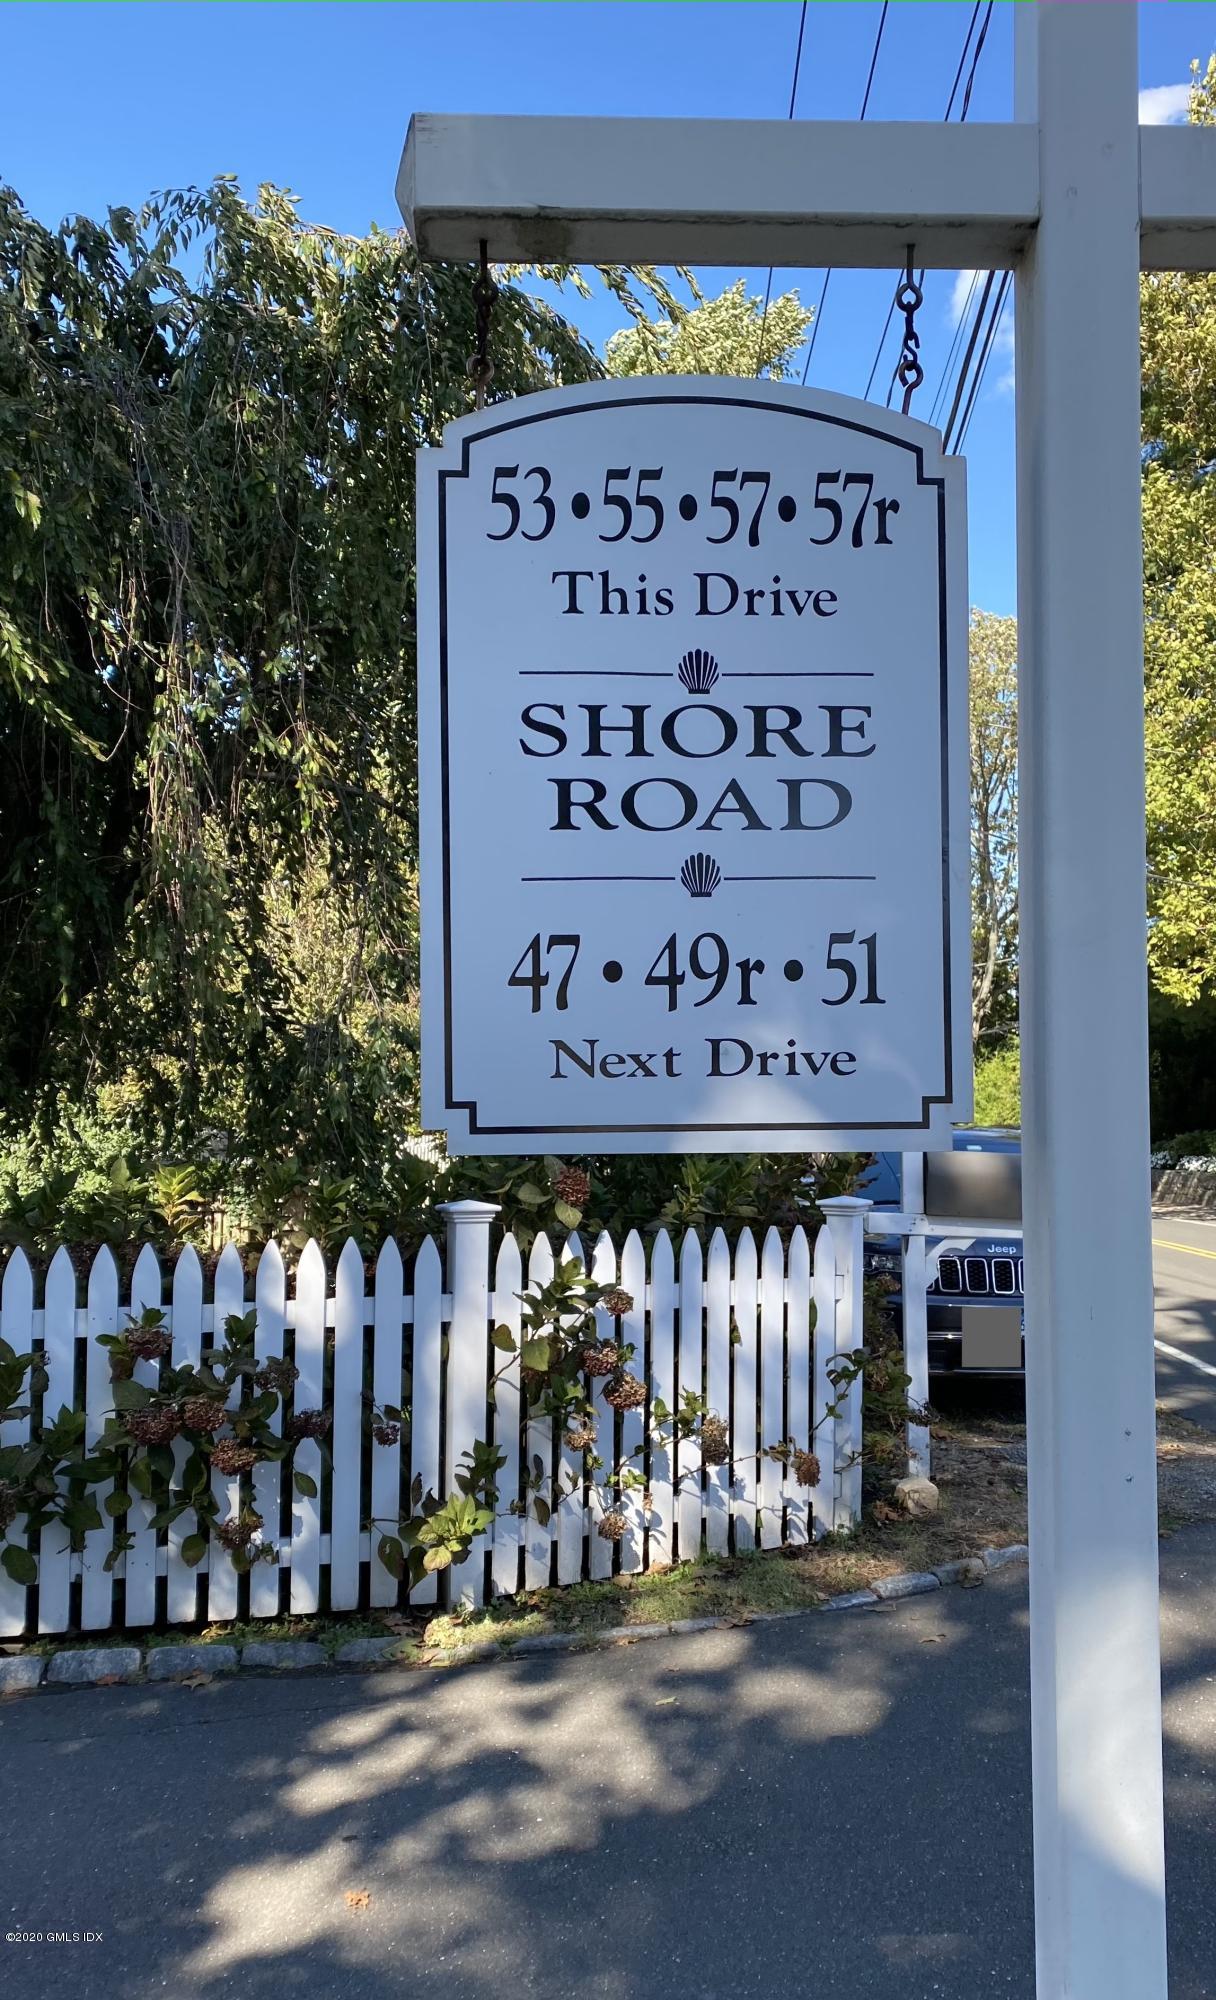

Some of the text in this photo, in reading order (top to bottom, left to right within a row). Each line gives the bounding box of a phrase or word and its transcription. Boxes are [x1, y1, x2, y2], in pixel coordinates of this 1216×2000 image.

[551, 570, 838, 618] This Drive
[519, 702, 877, 759] SHORE
[546, 777, 853, 832] ROAD
[507, 929, 887, 1014] 47 49r 51
[548, 1037, 857, 1079] Next Drive
[987, 1244, 1017, 1255] Jeep
